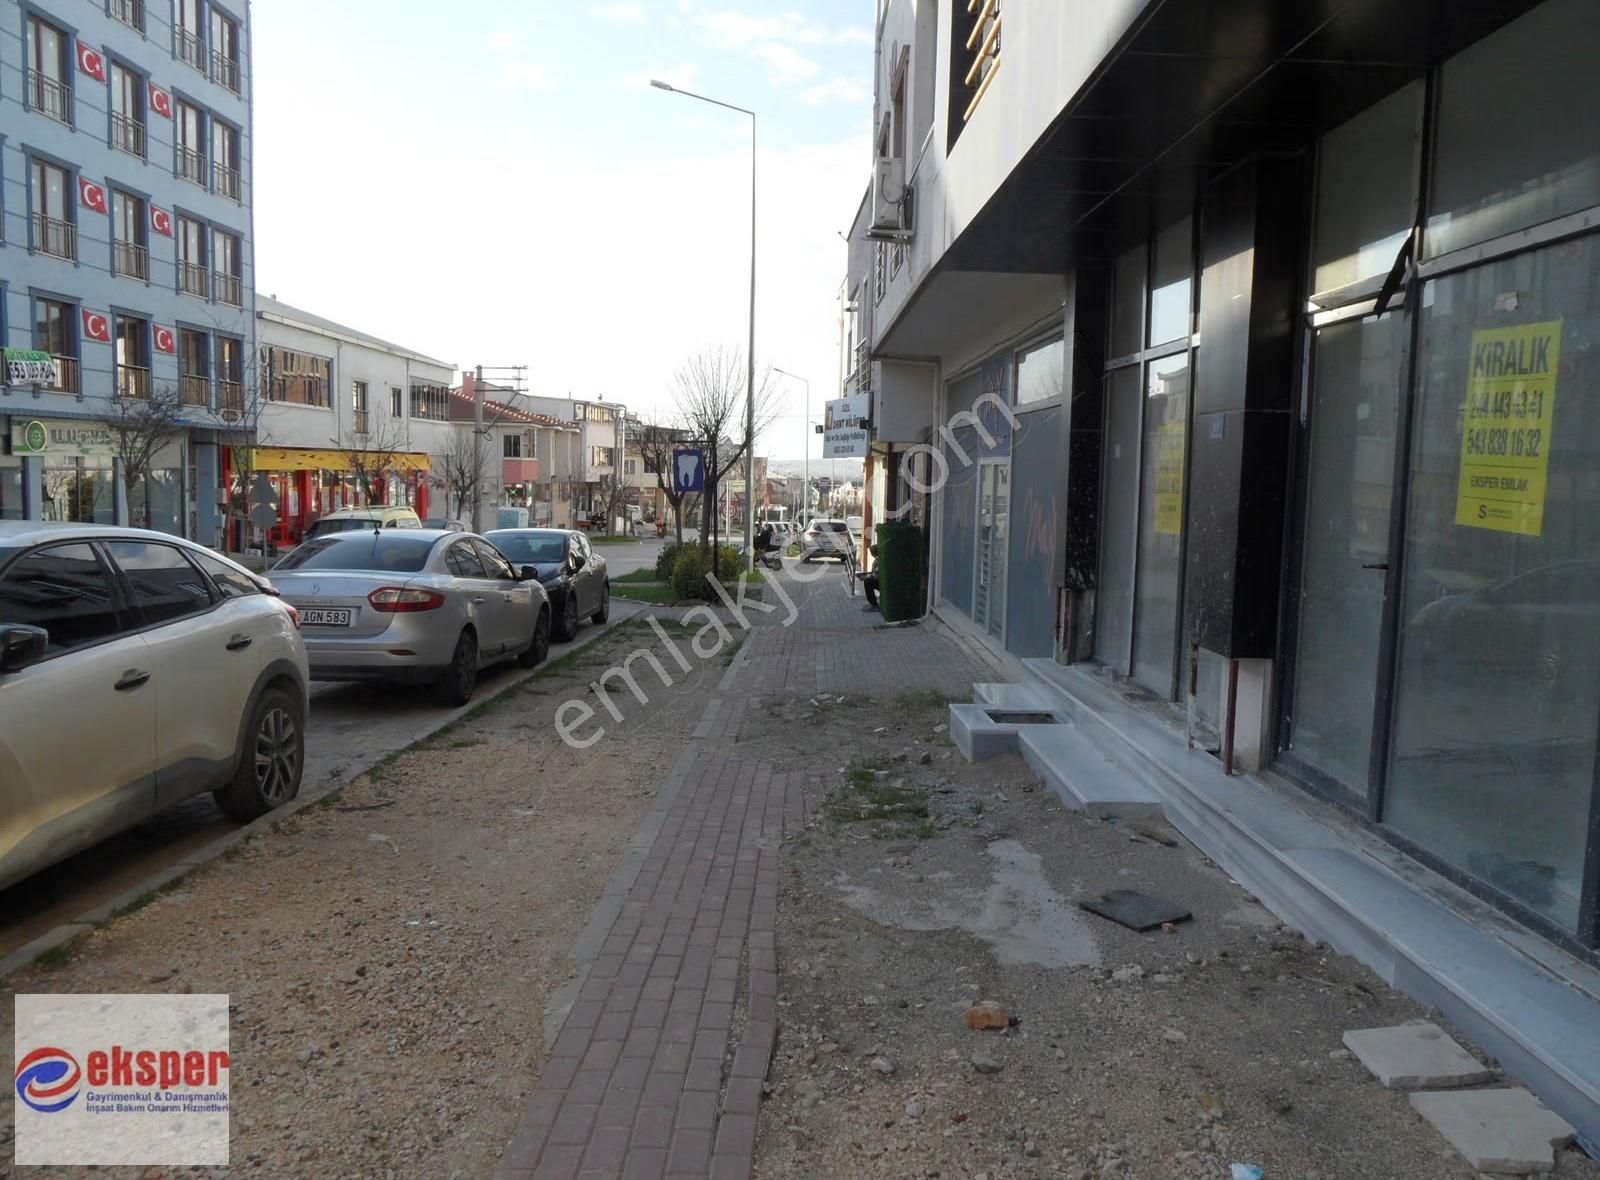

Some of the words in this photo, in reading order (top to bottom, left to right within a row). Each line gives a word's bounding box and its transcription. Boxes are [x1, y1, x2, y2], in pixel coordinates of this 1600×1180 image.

[1466, 428, 1487, 456] 543
[1511, 428, 1525, 457] 16
[1525, 428, 1542, 457] 32
[1470, 475, 1499, 489] EKSPER
[1500, 477, 1529, 492] EMLAK
[303, 611, 324, 623] AGN
[326, 611, 347, 623] 583
